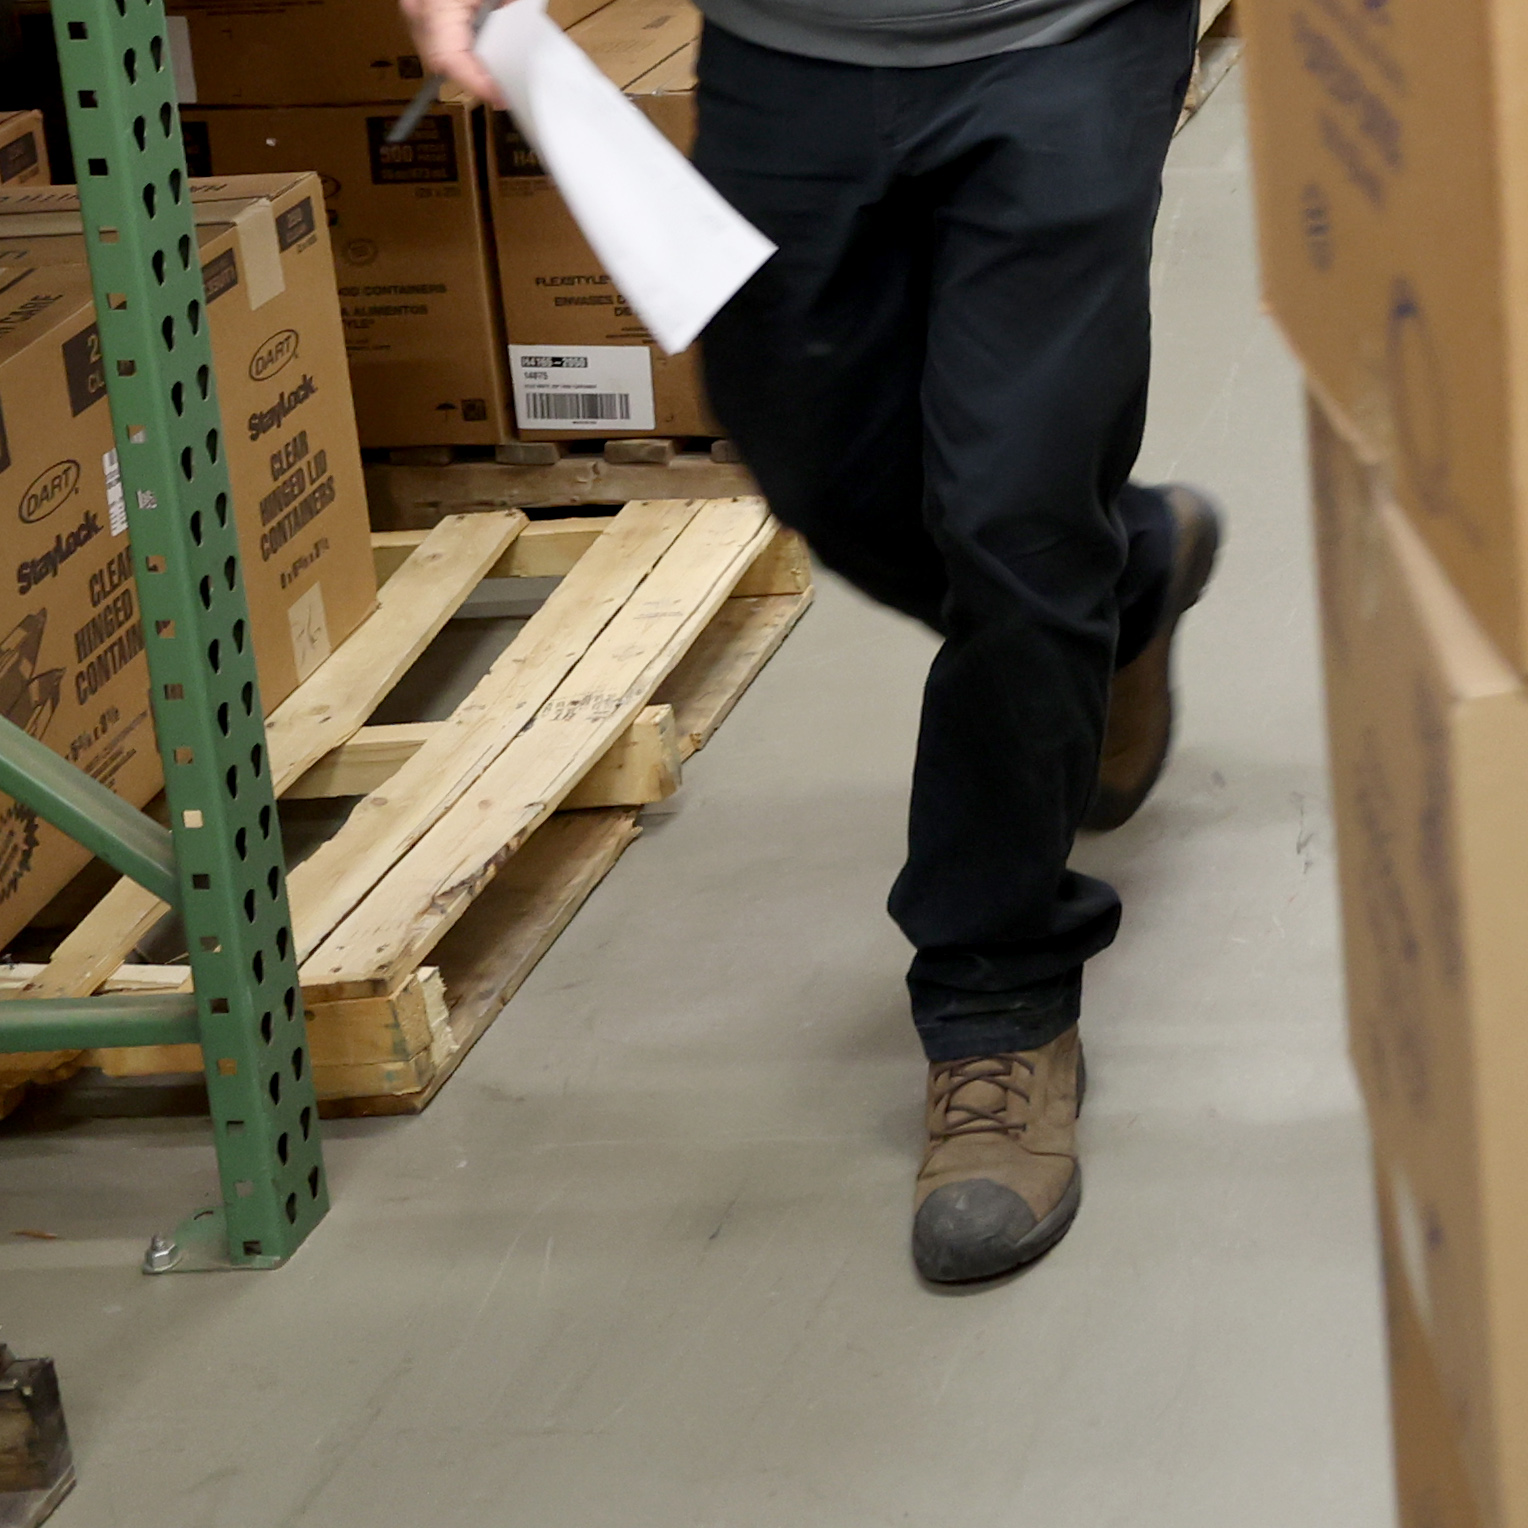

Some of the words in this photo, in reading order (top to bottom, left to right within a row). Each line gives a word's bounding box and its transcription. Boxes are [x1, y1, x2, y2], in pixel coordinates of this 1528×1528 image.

[255, 337, 293, 374] DART
[270, 430, 309, 482] CLEAR
[25, 468, 71, 518] DART
[260, 468, 306, 528] HINGED
[307, 450, 328, 486] LID
[260, 475, 336, 563] CONTAINERS
[74, 589, 133, 664] HINGED
